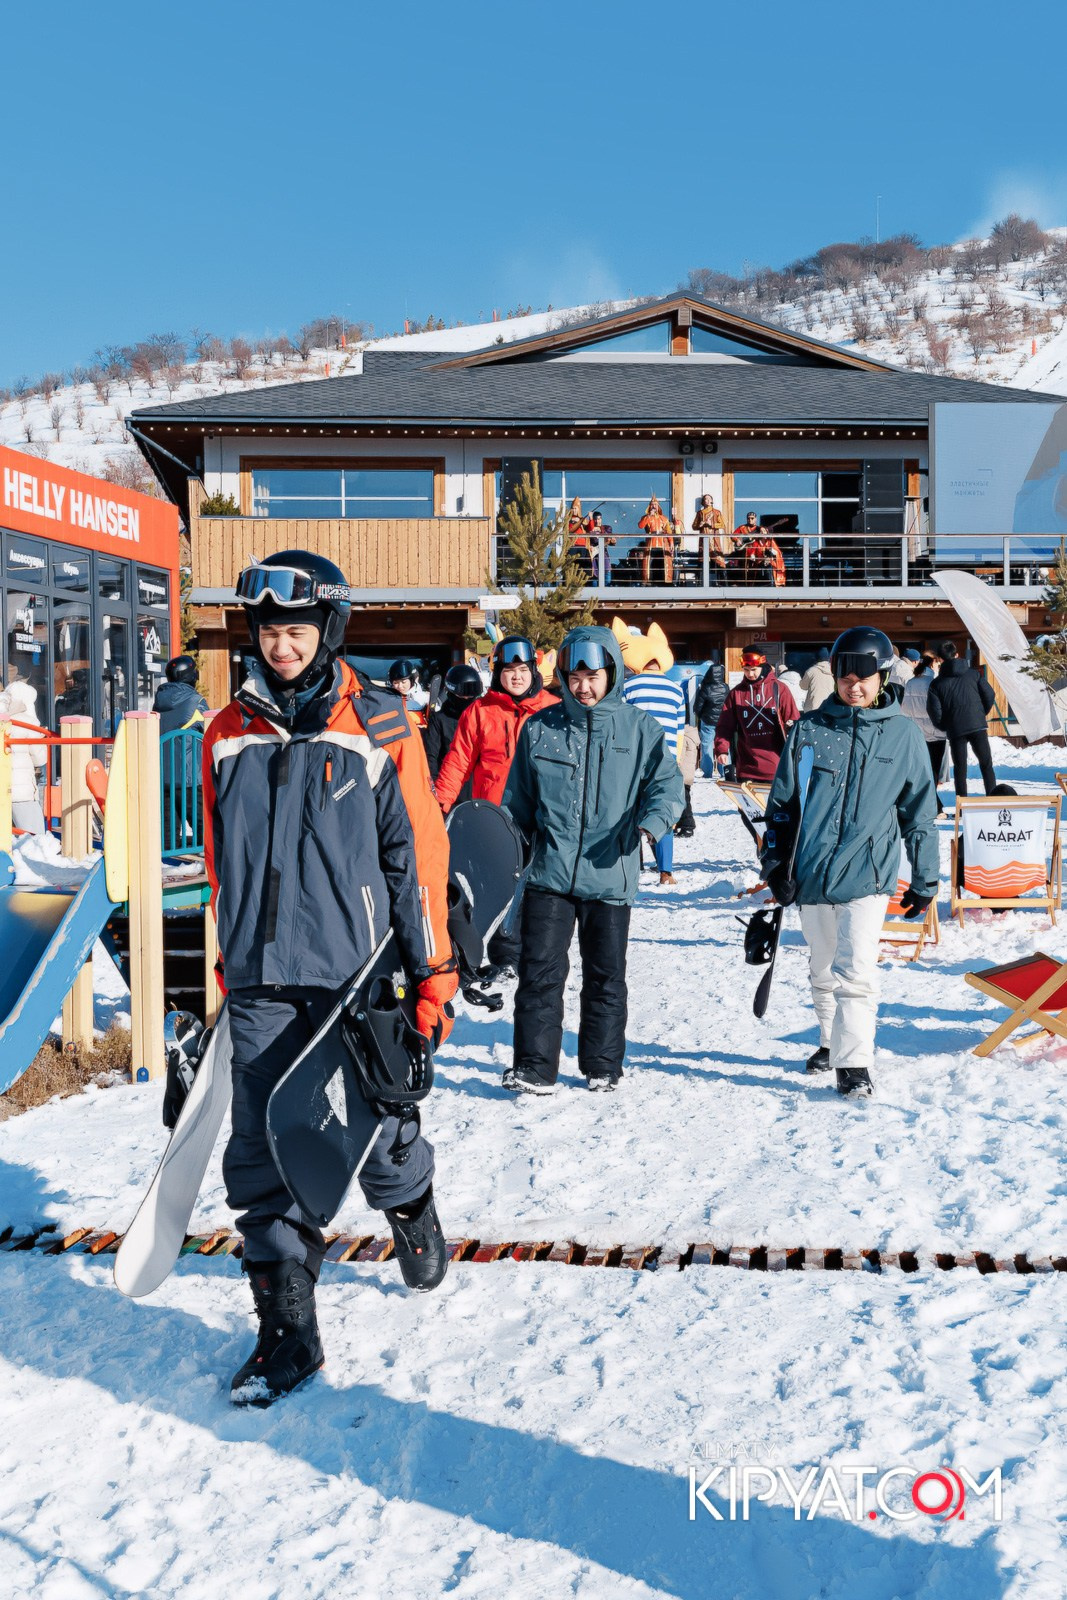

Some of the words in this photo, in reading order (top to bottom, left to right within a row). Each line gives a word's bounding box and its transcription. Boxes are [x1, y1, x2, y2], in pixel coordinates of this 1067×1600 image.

[4, 467, 65, 521] HELLY
[70, 489, 140, 543] HANSEN
[977, 829, 1033, 842] ARARAT
